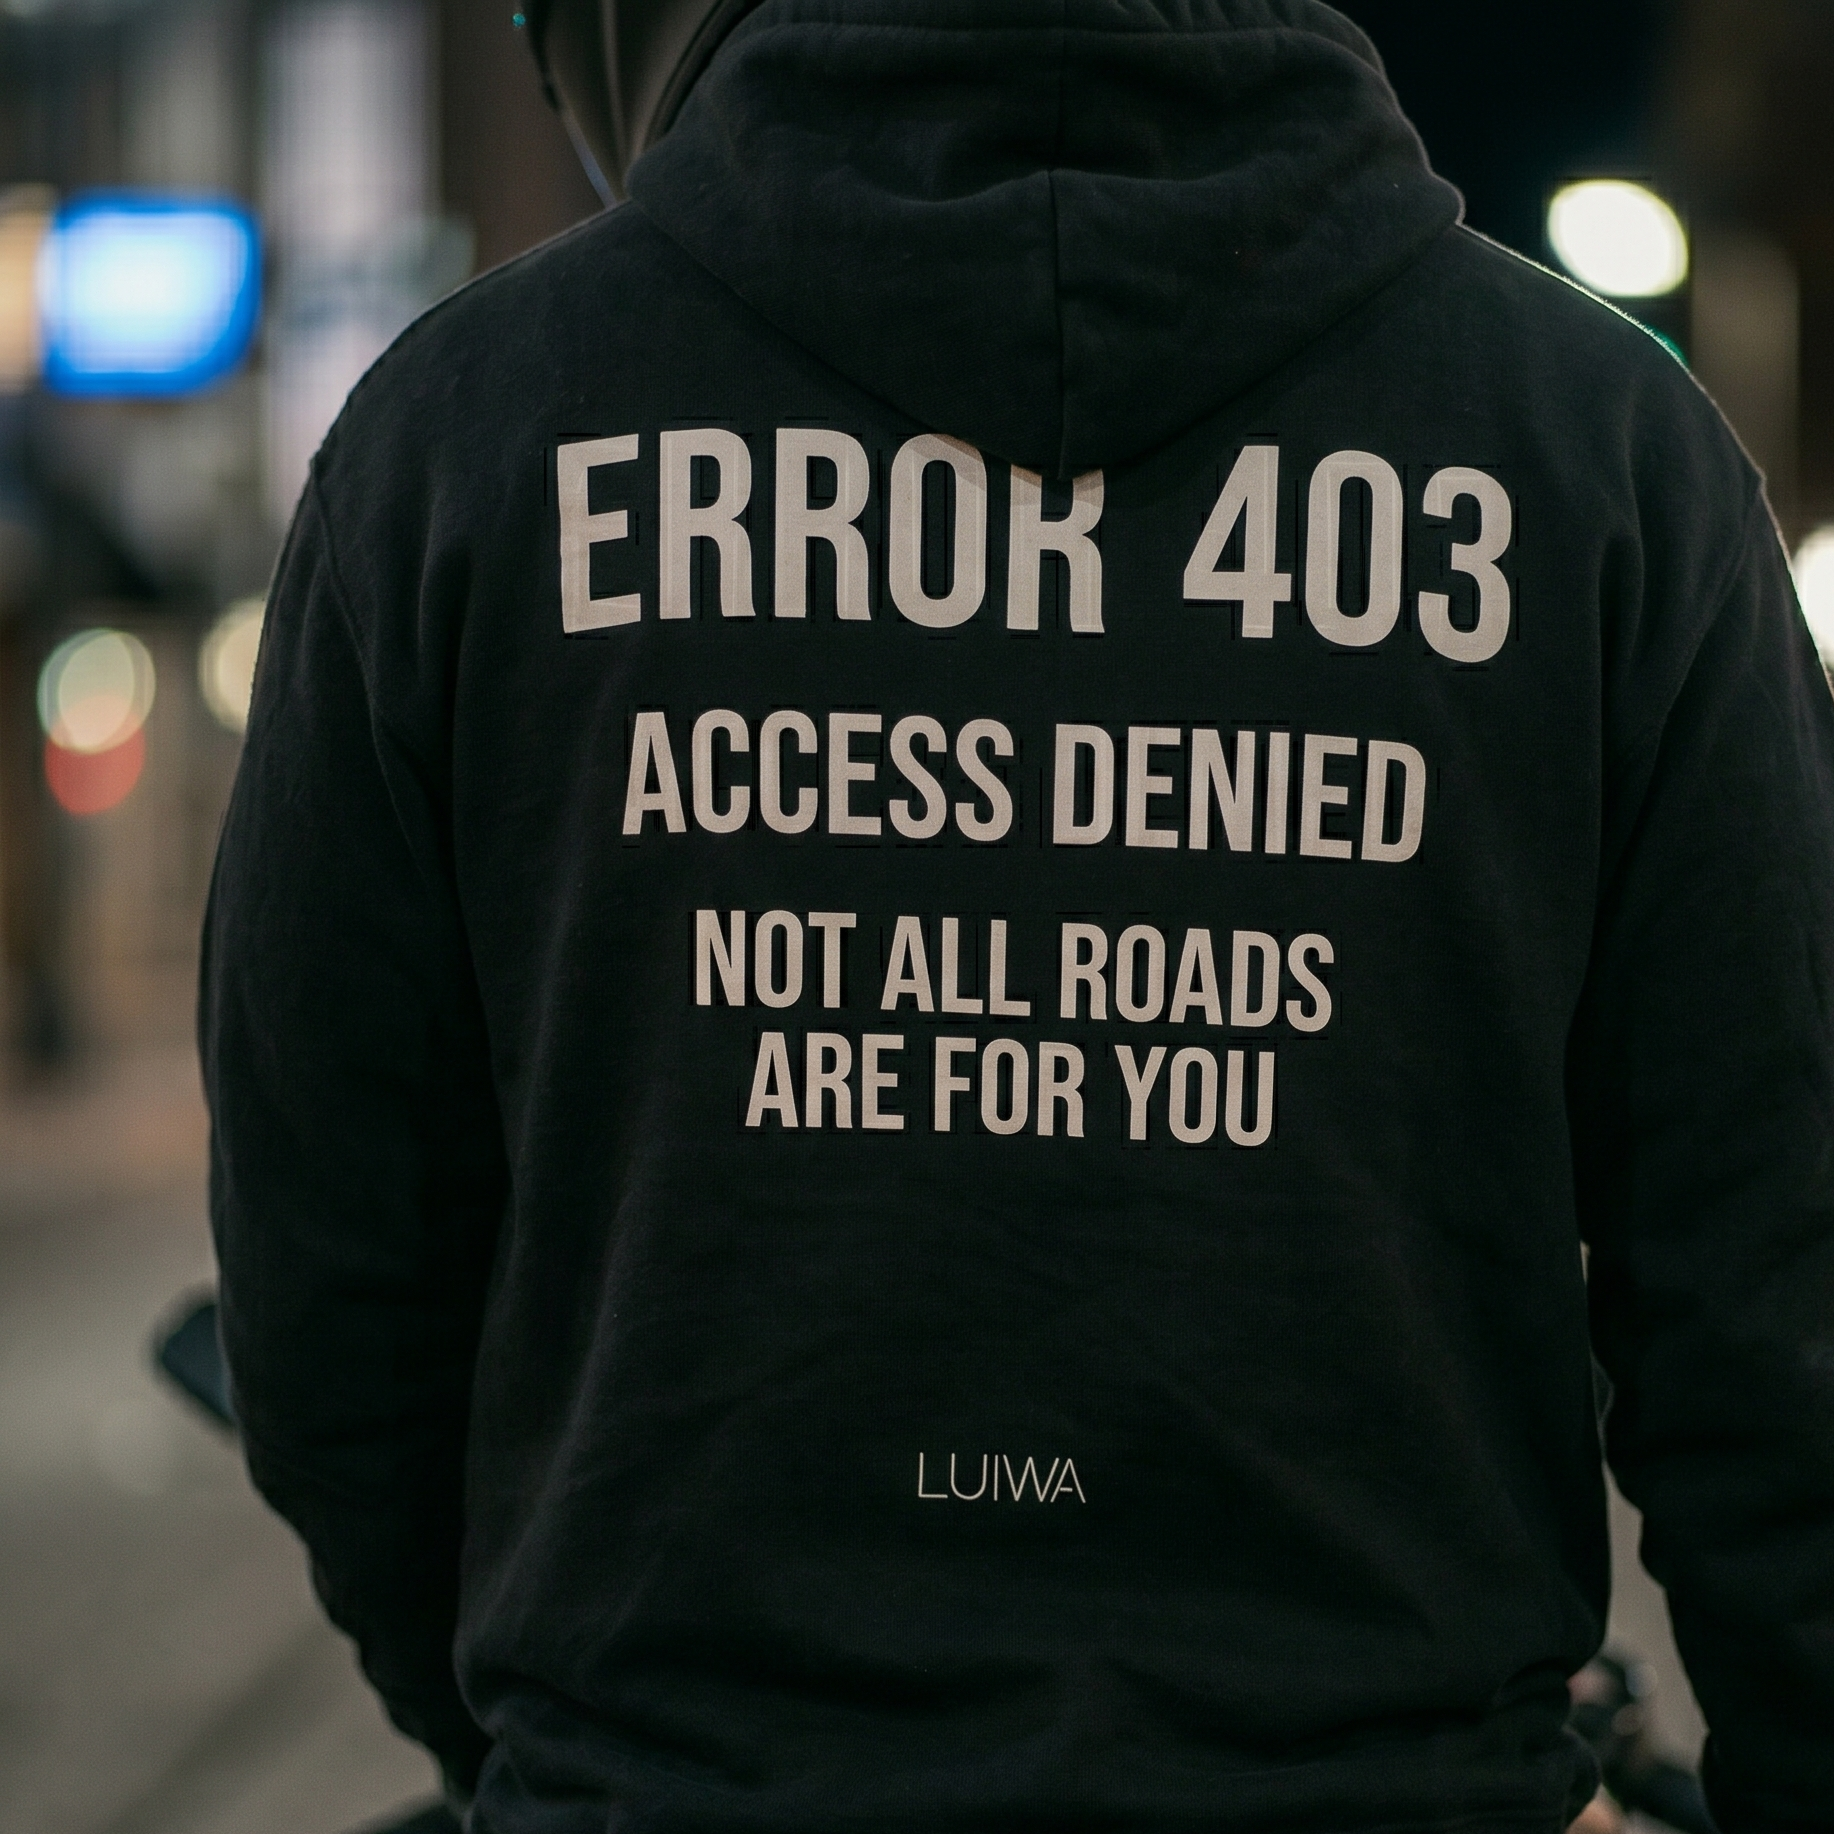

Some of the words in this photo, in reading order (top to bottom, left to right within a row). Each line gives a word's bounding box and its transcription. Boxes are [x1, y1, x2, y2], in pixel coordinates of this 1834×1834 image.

[556, 427, 1106, 635] ERROR
[1182, 445, 1512, 663] 403
[622, 708, 1014, 842] ACCESS
[1052, 723, 1427, 863] DENIED
[696, 909, 857, 1009] NOT
[880, 915, 1031, 1017] ALL
[1060, 922, 1335, 1033] ROADS
[745, 1031, 905, 1131] ARE
[934, 1036, 1085, 1138] FOR
[1114, 1044, 1275, 1147] YOU
[917, 1452, 1086, 1504] LUIWA
